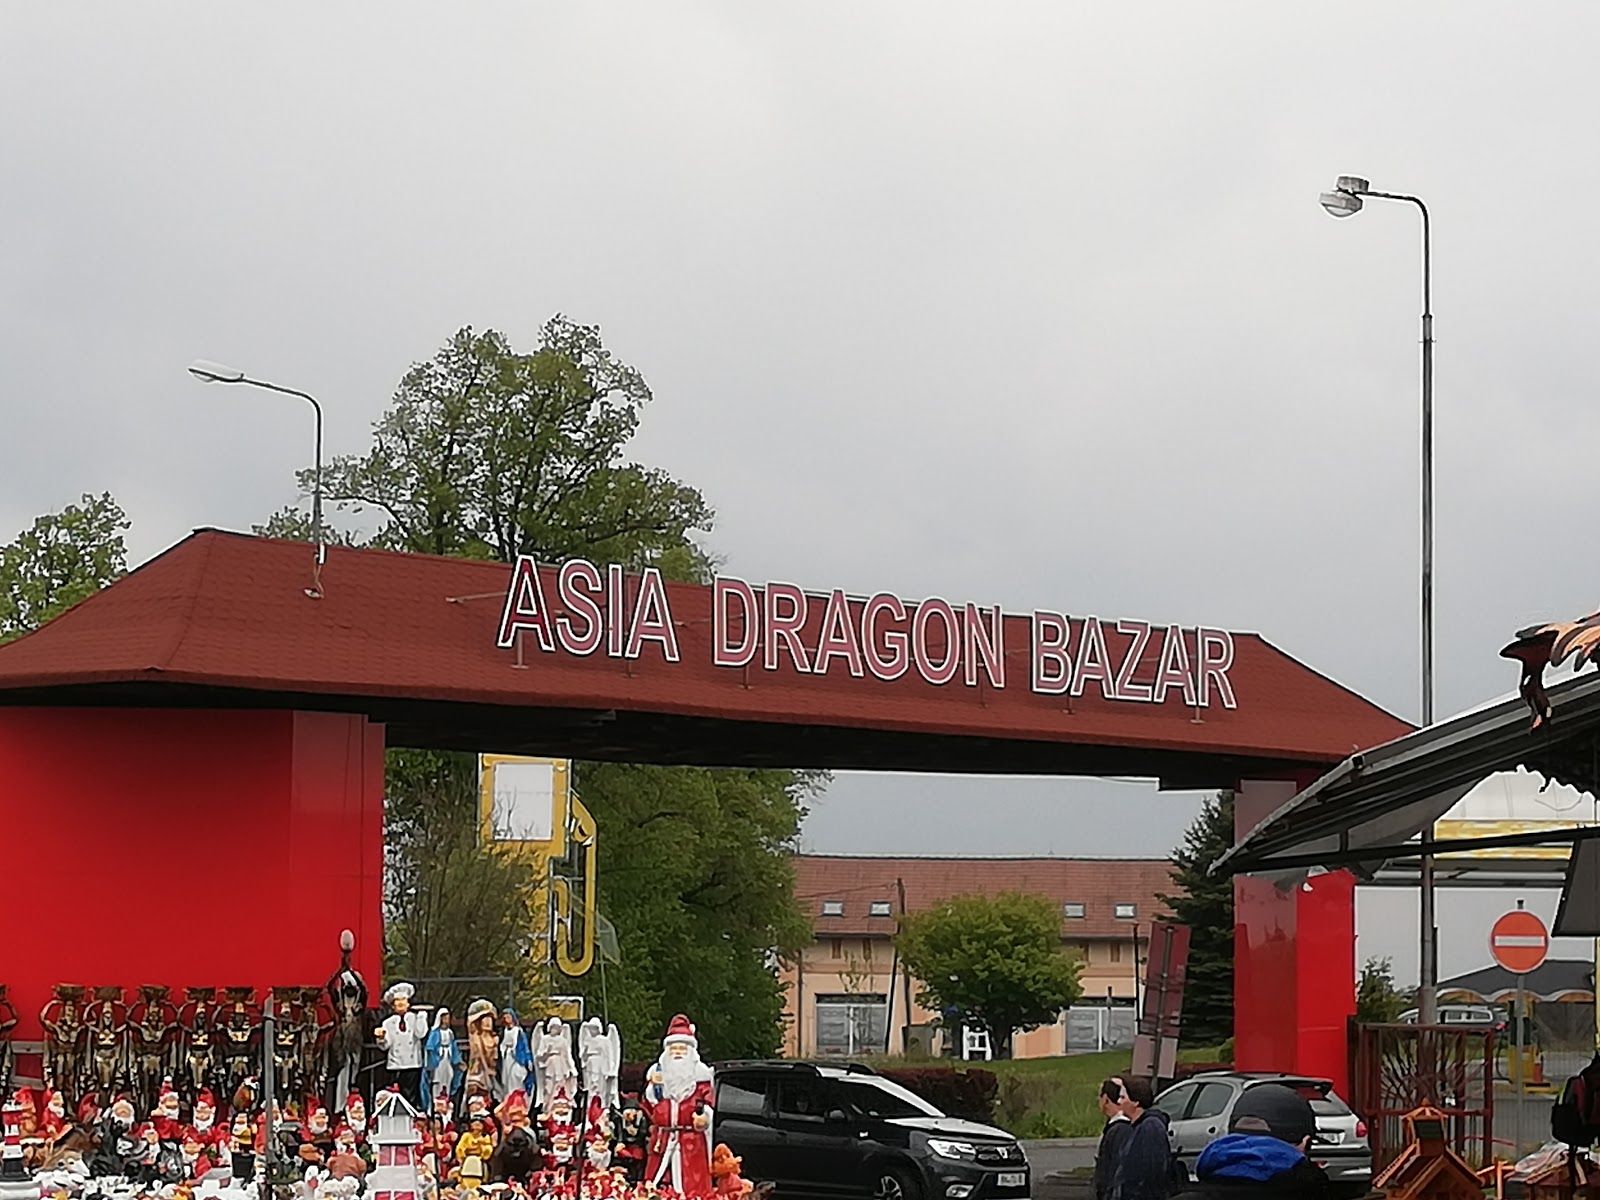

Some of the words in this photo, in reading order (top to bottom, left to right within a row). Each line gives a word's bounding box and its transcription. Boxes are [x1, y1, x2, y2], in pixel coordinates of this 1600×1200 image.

[497, 554, 680, 663] ASIA
[712, 574, 1005, 689] DRAGON
[1030, 608, 1237, 709] BAZAR
